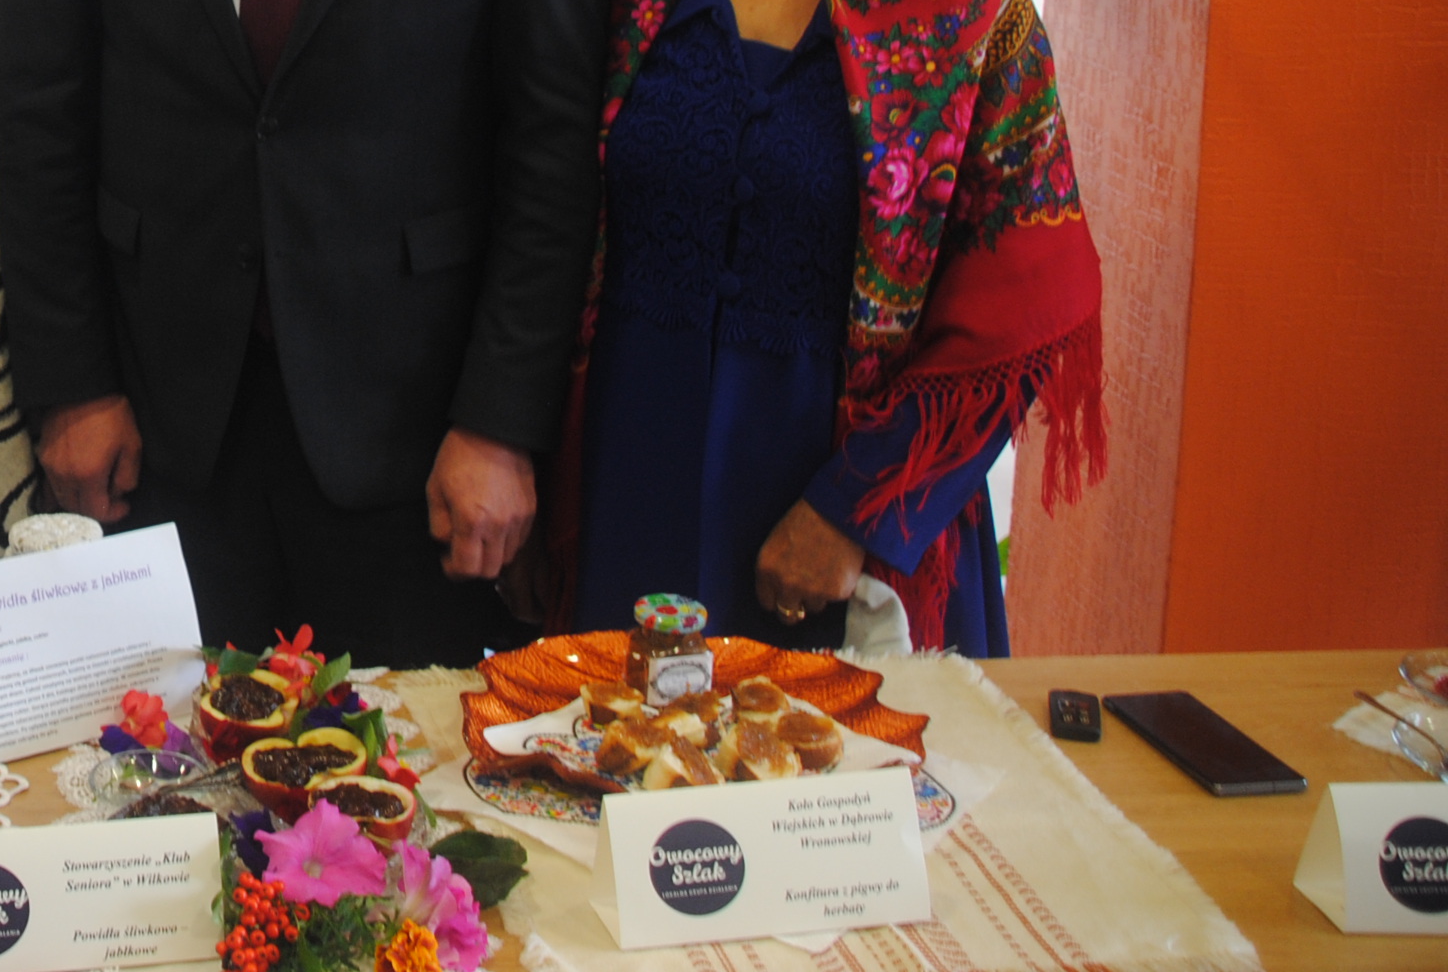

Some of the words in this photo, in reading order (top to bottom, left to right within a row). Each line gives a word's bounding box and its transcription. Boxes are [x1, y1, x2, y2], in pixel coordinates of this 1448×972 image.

[30, 581, 87, 603] śliwkowe
[91, 578, 99, 590] z
[101, 563, 152, 591] jabłkami
[788, 797, 815, 813] Koło
[817, 792, 871, 811] Gospodyń
[771, 816, 825, 835] Wiejskich
[829, 818, 839, 827] w
[841, 808, 894, 829] Dąbrowie
[800, 830, 872, 850] Wronowskiej
[1379, 839, 1448, 863] Owoco
[62, 854, 152, 873] Stowarzyszenie
[649, 842, 743, 869] Owocowy
[122, 879, 133, 889] w
[136, 871, 191, 889] Wilkowie
[671, 861, 726, 886] Szlak
[1402, 860, 1448, 883] Szla
[785, 885, 840, 903] Konfitura
[850, 882, 885, 901] pigwy
[886, 879, 900, 893] do
[823, 900, 866, 918] herbaty
[73, 926, 121, 943] Powidła
[124, 923, 179, 938] śliwkowo
[104, 945, 158, 962] jabłkowe
